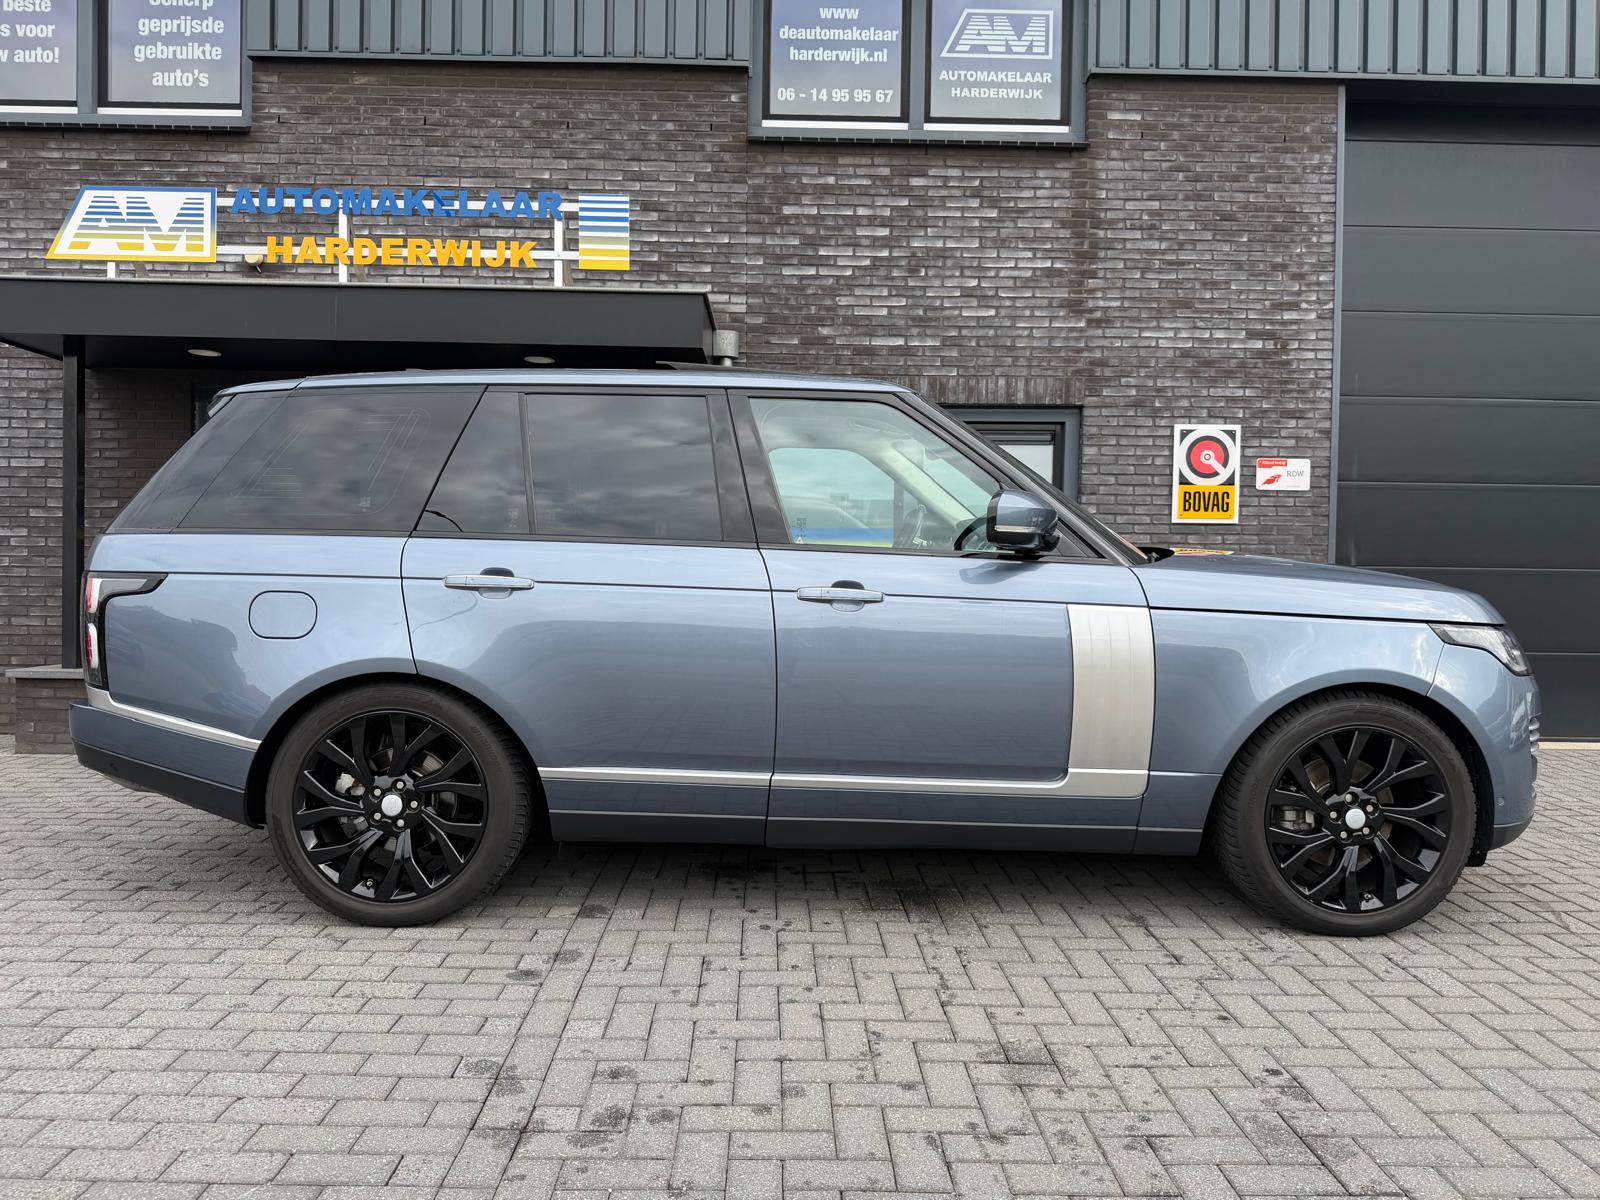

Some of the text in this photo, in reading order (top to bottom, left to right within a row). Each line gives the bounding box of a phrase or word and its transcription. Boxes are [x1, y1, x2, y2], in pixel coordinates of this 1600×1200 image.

[3, 0, 51, 11] beste
[819, 8, 859, 19] www
[16, 24, 55, 37] voor
[138, 16, 224, 36] geprijsde
[779, 25, 899, 41] deautomakelaar
[955, 15, 1046, 53] AM
[14, 47, 59, 63] auto!
[134, 42, 222, 62] gebruikte
[789, 47, 888, 64] harderwijk.nl
[152, 69, 209, 87] auto's
[939, 70, 1052, 83] AUTOMAKELAAR
[777, 88, 795, 100] 06
[810, 88, 828, 101] 14
[832, 89, 849, 102] 95
[854, 89, 871, 102] 95
[876, 90, 894, 103] 67
[951, 87, 1043, 99] HARDERWIJK
[231, 187, 563, 220] AUTOMAKELAAR
[68, 195, 204, 252] AM
[266, 236, 537, 269] HARDERWIJK
[1183, 491, 1230, 513] BOVAG
